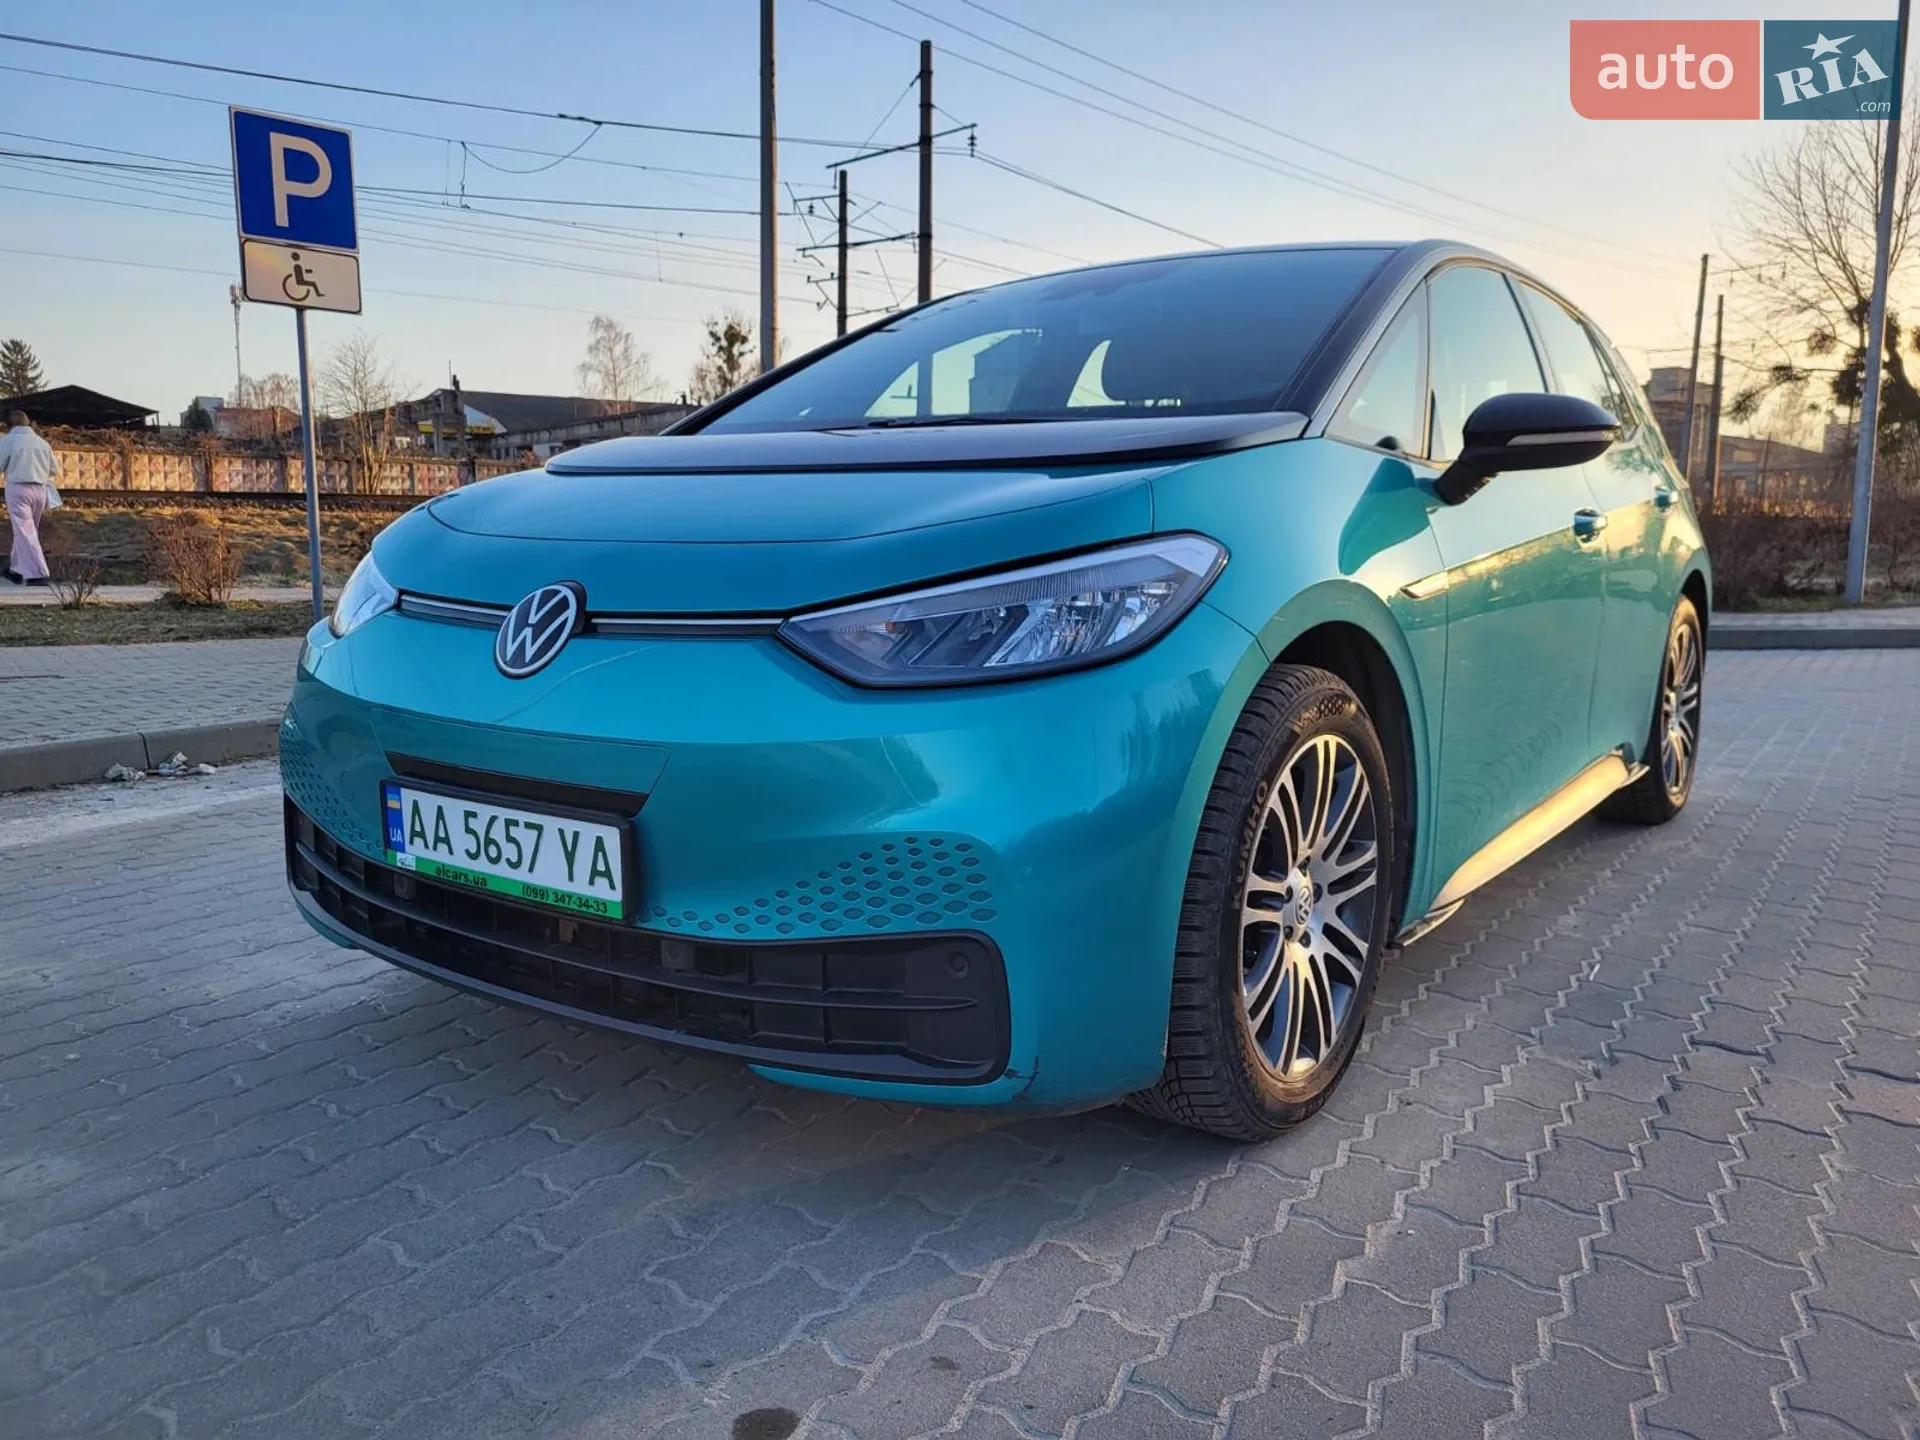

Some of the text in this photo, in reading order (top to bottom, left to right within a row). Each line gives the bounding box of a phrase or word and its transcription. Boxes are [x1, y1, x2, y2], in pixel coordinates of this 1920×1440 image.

[269, 132, 332, 227] P
[389, 827, 404, 843] UA
[409, 799, 616, 890] AA 5657 YA
[435, 865, 488, 887] elcars.ua
[522, 884, 608, 914] (099) 347-34-33
